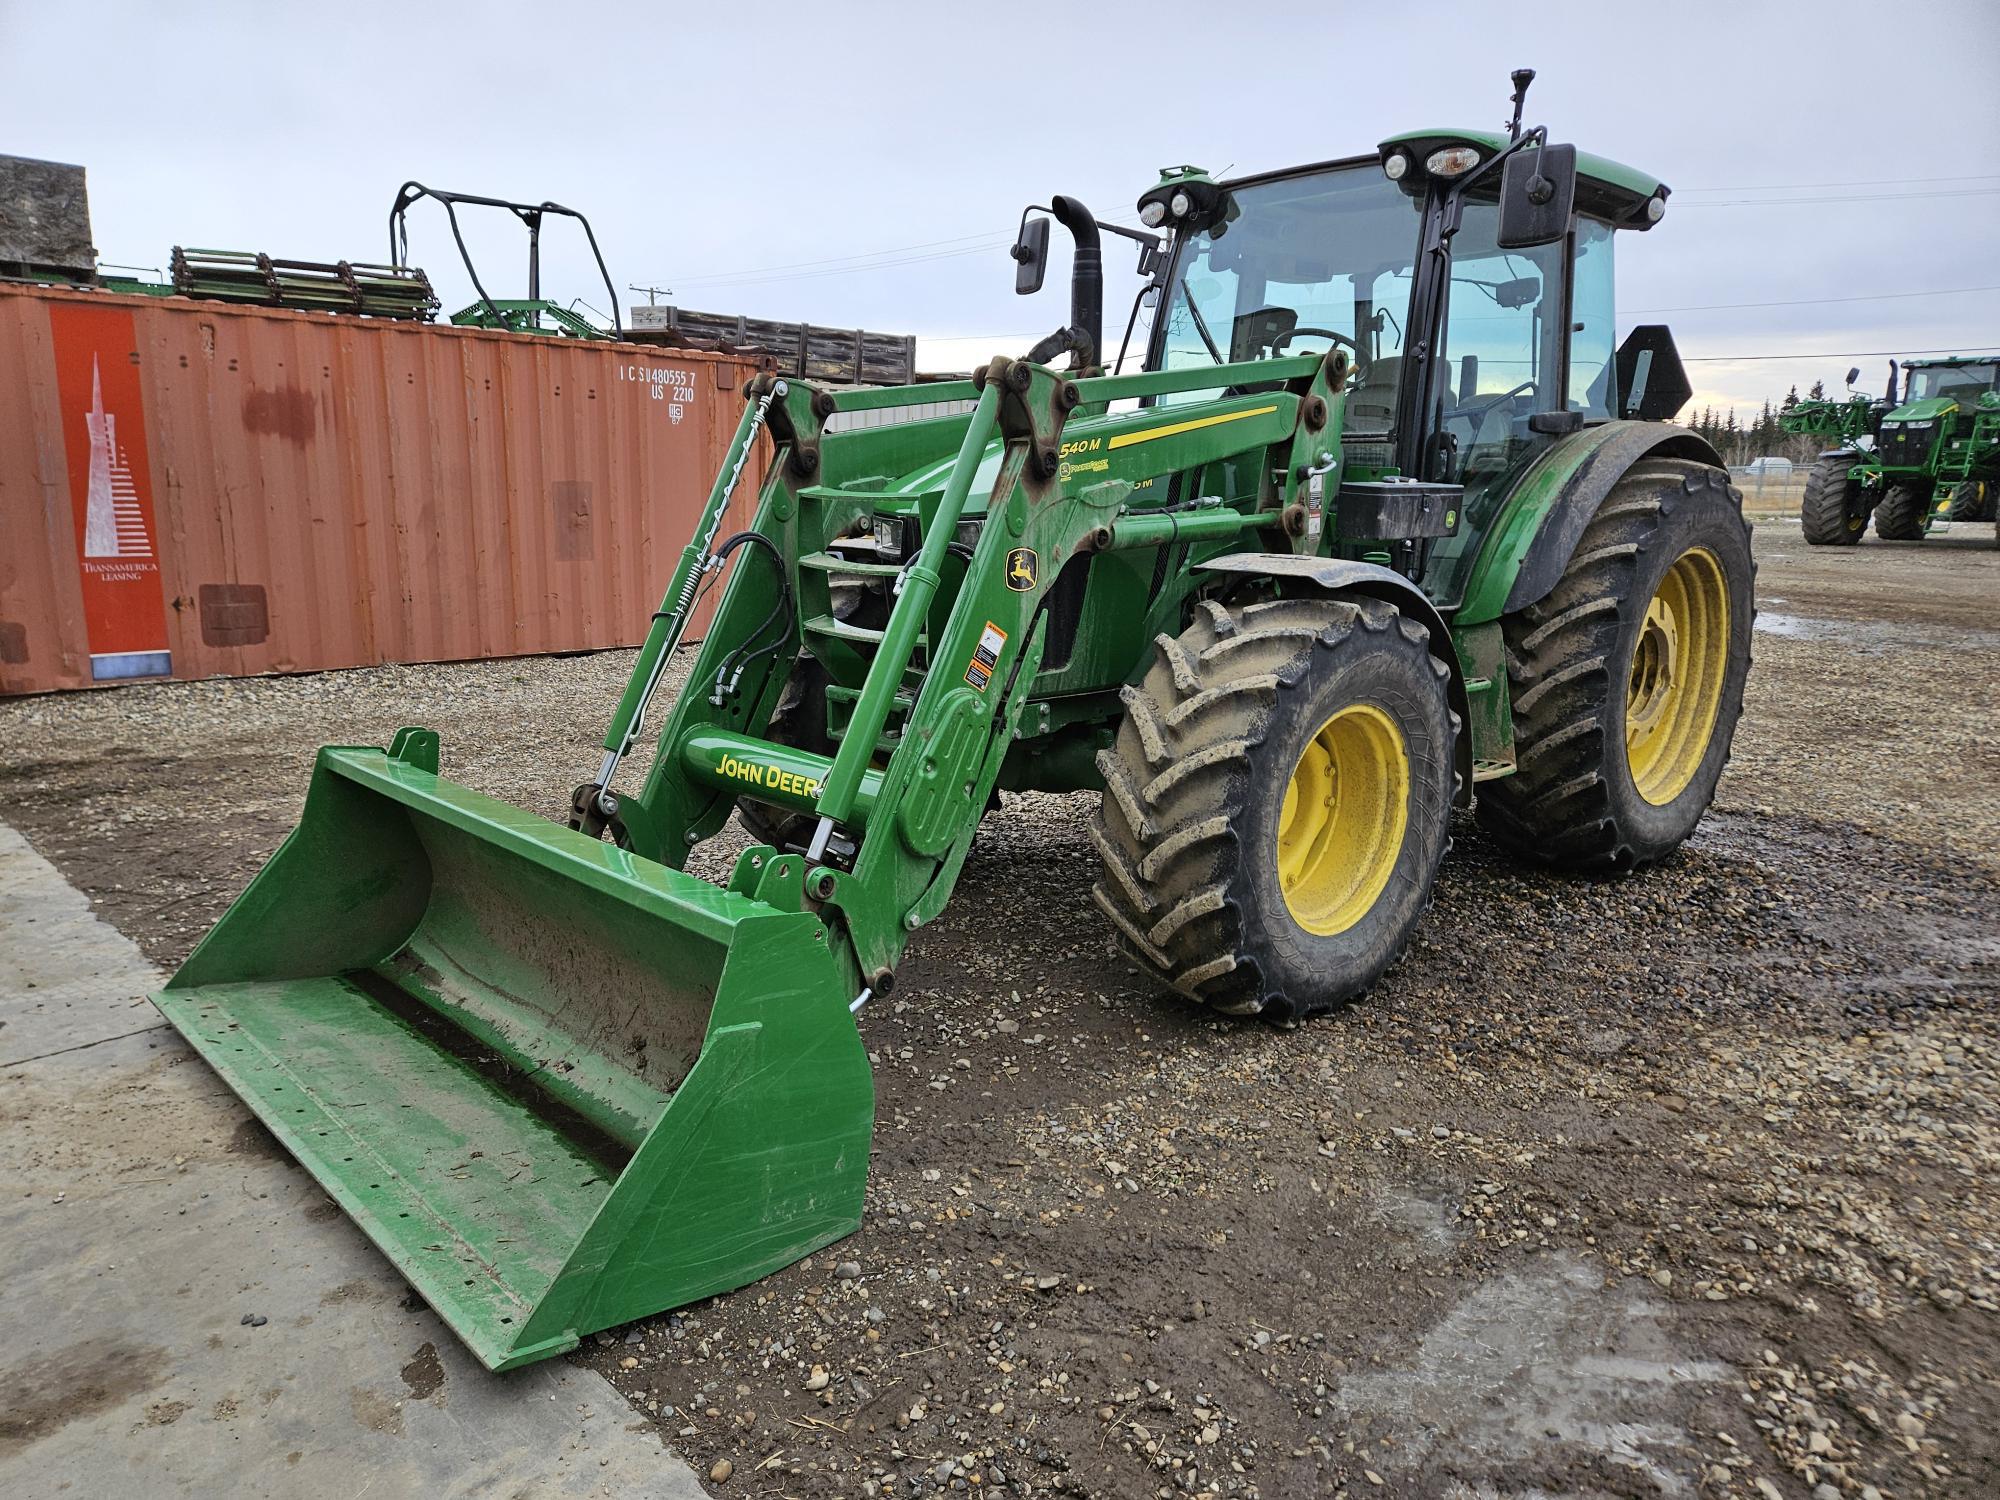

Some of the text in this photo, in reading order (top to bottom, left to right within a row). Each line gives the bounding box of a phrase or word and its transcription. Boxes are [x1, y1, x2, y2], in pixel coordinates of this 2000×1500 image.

[652, 384, 693, 402] US 2210
[102, 572, 142, 581] LEASING
[716, 754, 818, 797] JOHN DEER
